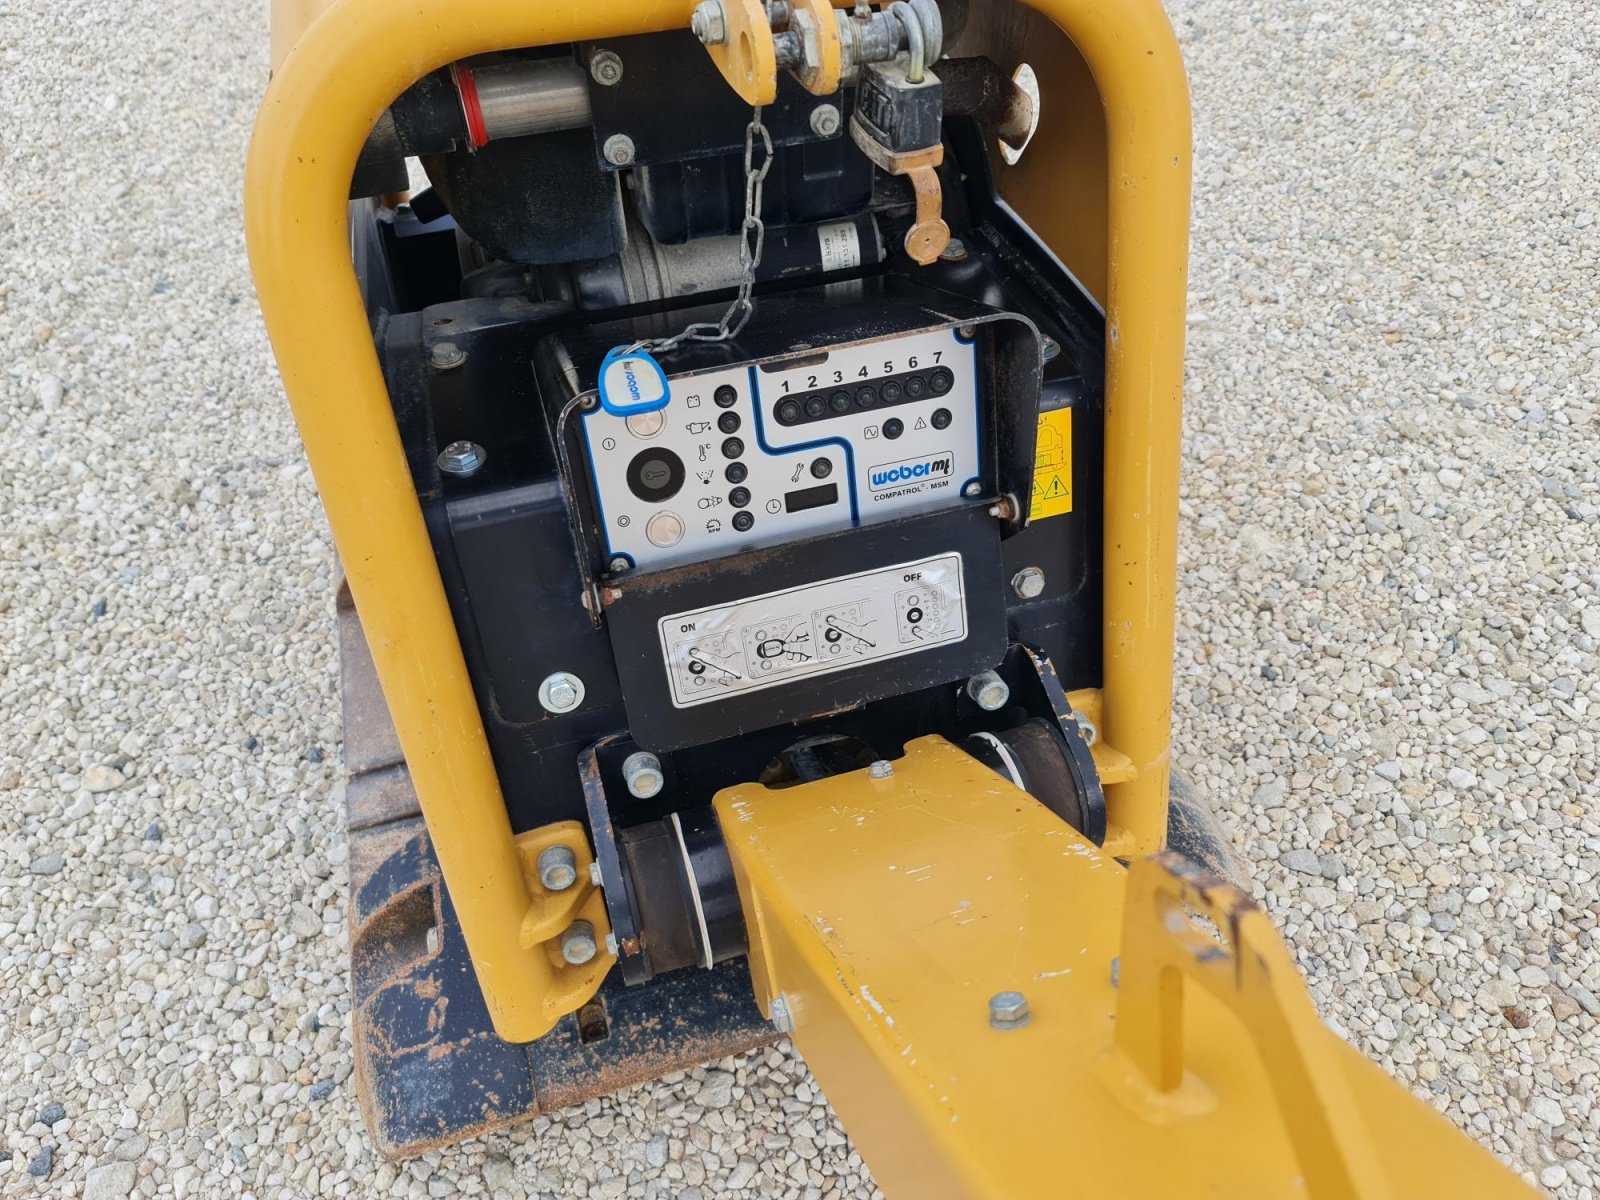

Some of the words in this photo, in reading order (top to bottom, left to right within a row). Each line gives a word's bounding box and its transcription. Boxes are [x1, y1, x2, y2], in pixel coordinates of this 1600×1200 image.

[781, 380, 790, 393] 1
[807, 375, 818, 388] 2
[833, 370, 843, 383] 3
[858, 365, 868, 378] 4
[883, 360, 893, 374] 5
[908, 356, 918, 369] 6
[933, 351, 943, 364] 7
[930, 480, 949, 490] MSM
[903, 572, 922, 582] OFF
[680, 623, 696, 632] ON
